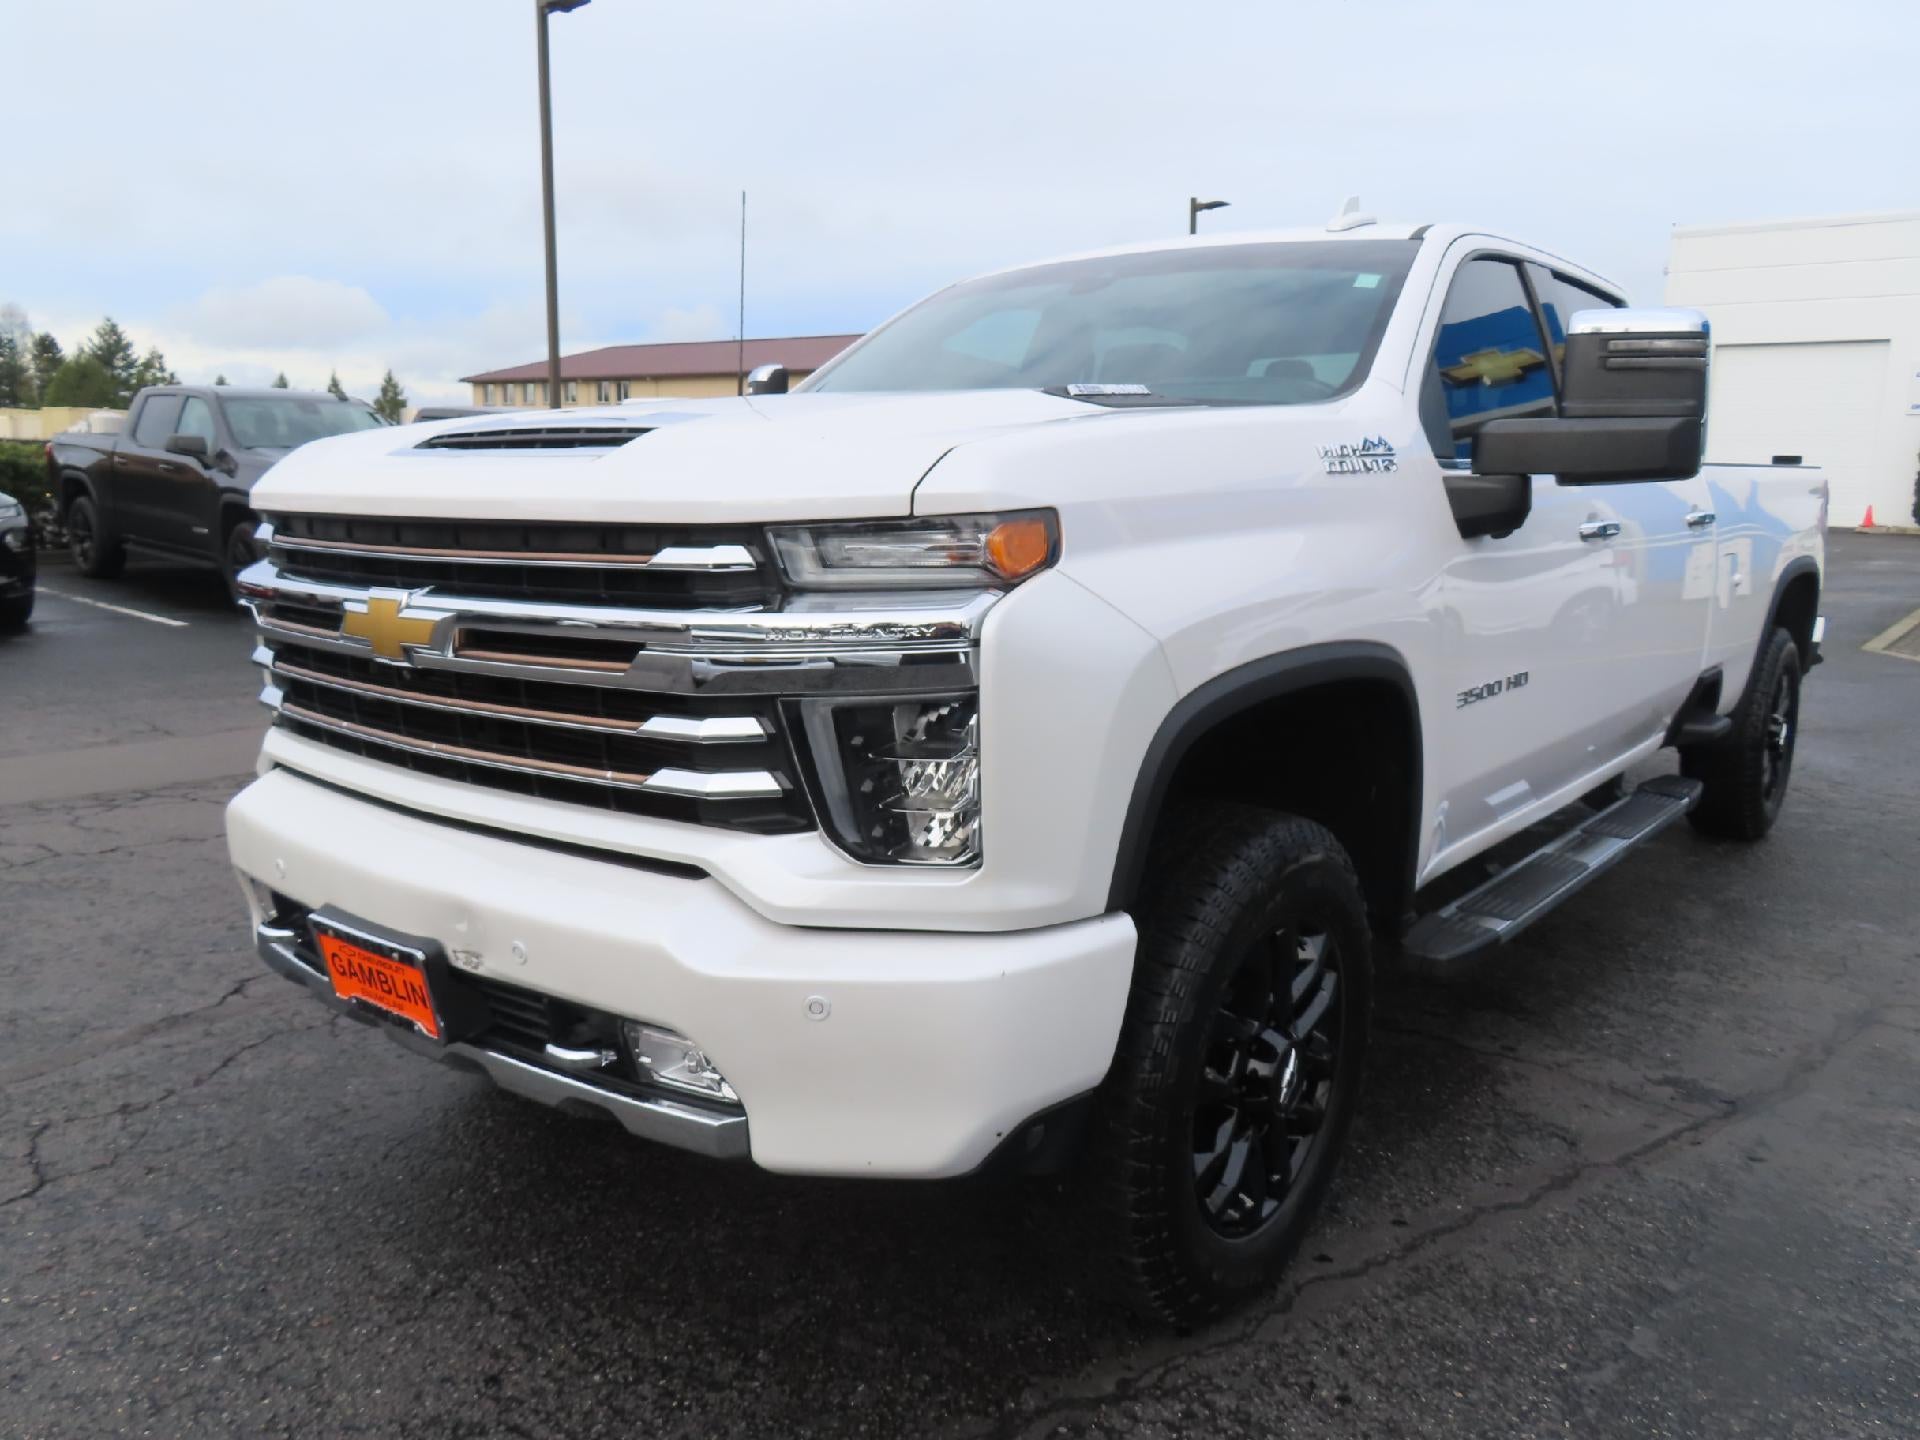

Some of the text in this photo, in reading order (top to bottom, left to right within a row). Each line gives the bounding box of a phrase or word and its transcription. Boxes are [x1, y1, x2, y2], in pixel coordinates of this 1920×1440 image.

[1456, 671, 1529, 710] 3500 HD
[330, 951, 430, 1010] GAMBLIN
